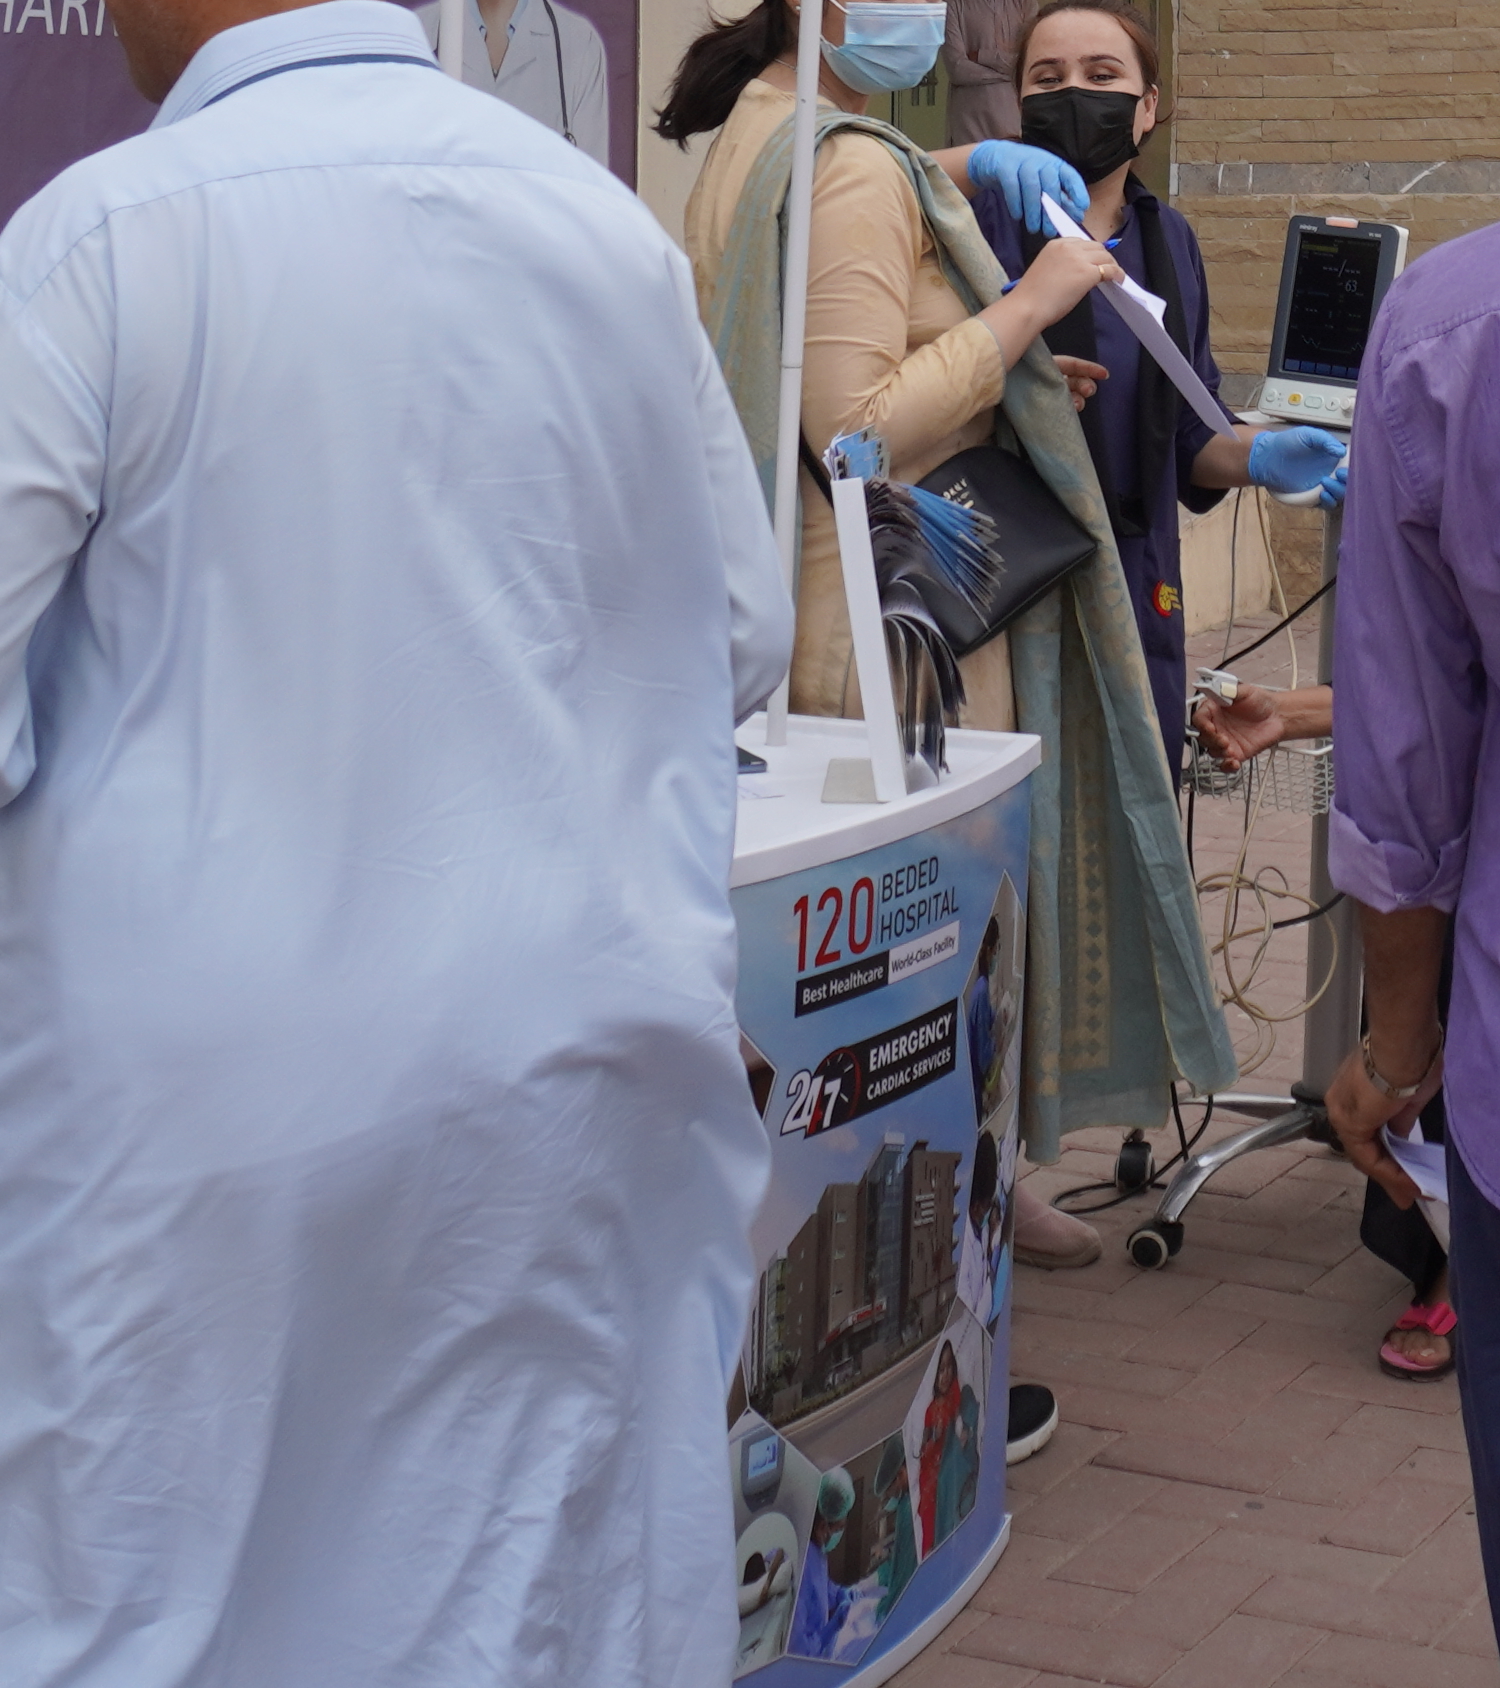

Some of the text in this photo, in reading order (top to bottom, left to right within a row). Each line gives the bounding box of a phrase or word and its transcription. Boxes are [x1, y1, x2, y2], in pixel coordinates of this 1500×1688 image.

[793, 855, 939, 974] 120 BEDED
[880, 886, 960, 945] HOSPITAL
[802, 935, 956, 1006] Best Healthcare World-Class Facility
[869, 1012, 953, 1073] EMERGENCY
[866, 1046, 951, 1101] CARDIAC SERVICES
